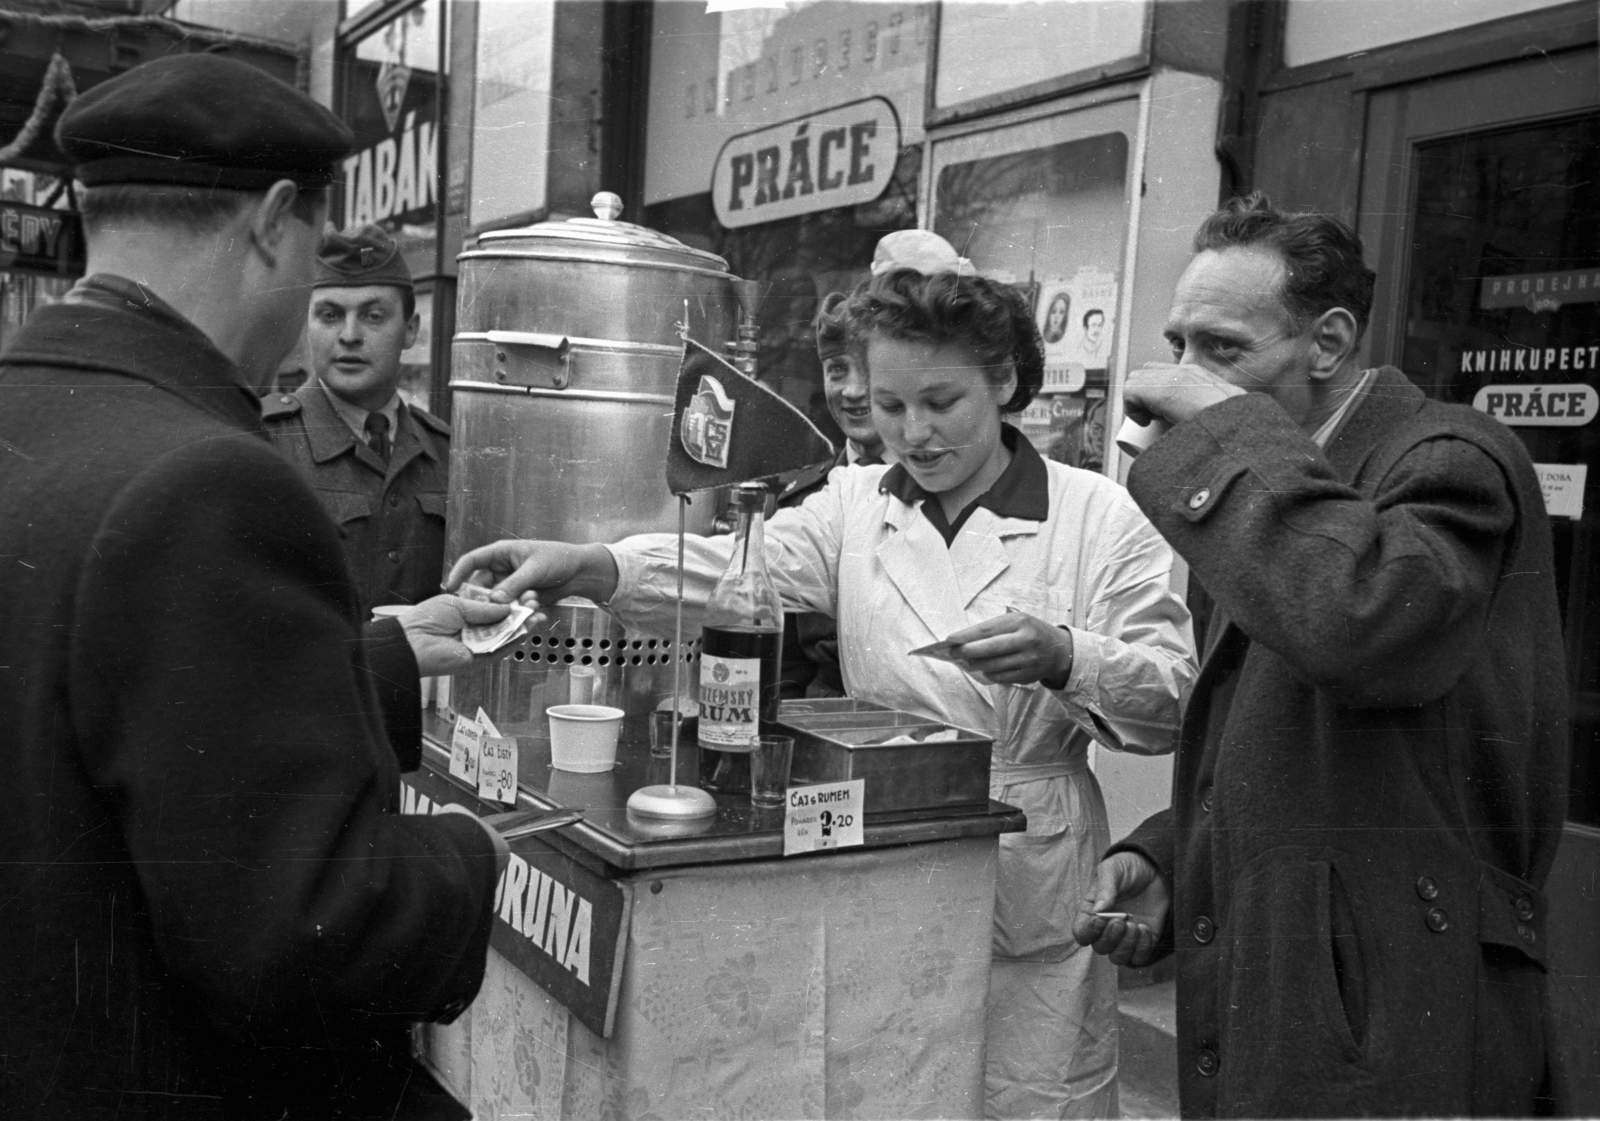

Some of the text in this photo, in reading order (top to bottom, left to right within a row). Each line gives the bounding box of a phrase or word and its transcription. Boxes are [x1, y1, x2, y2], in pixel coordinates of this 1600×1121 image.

[728, 119, 877, 213] PRÁCE
[1461, 346, 1599, 373] KNIHKUPECT
[1487, 387, 1587, 418] PRÁCE
[1547, 473, 1572, 482] DOBA
[790, 790, 809, 808] ČAJ
[817, 789, 850, 804] RUMEM
